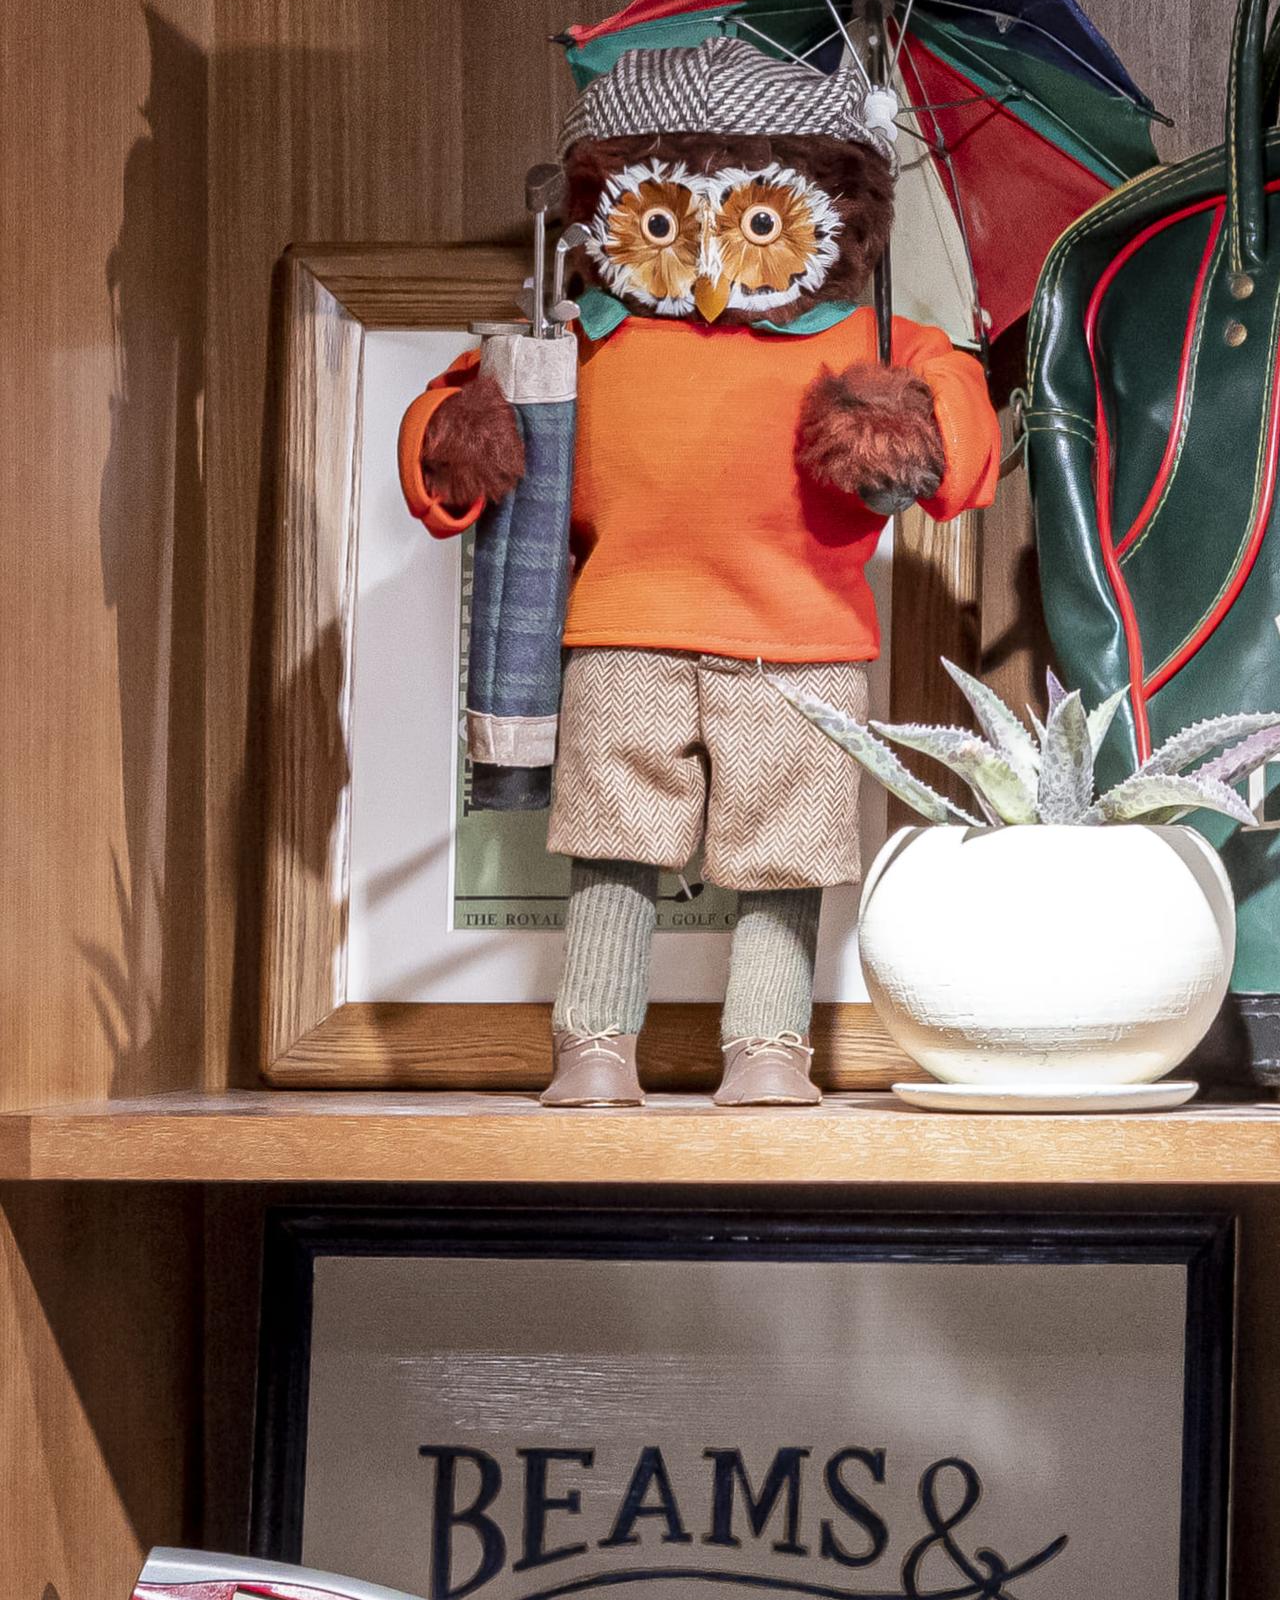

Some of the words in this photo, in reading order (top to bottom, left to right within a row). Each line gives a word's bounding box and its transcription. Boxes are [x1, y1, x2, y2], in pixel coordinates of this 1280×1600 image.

[464, 913, 498, 926] THE
[505, 913, 563, 926] ROYAL
[672, 913, 718, 927] GOLF
